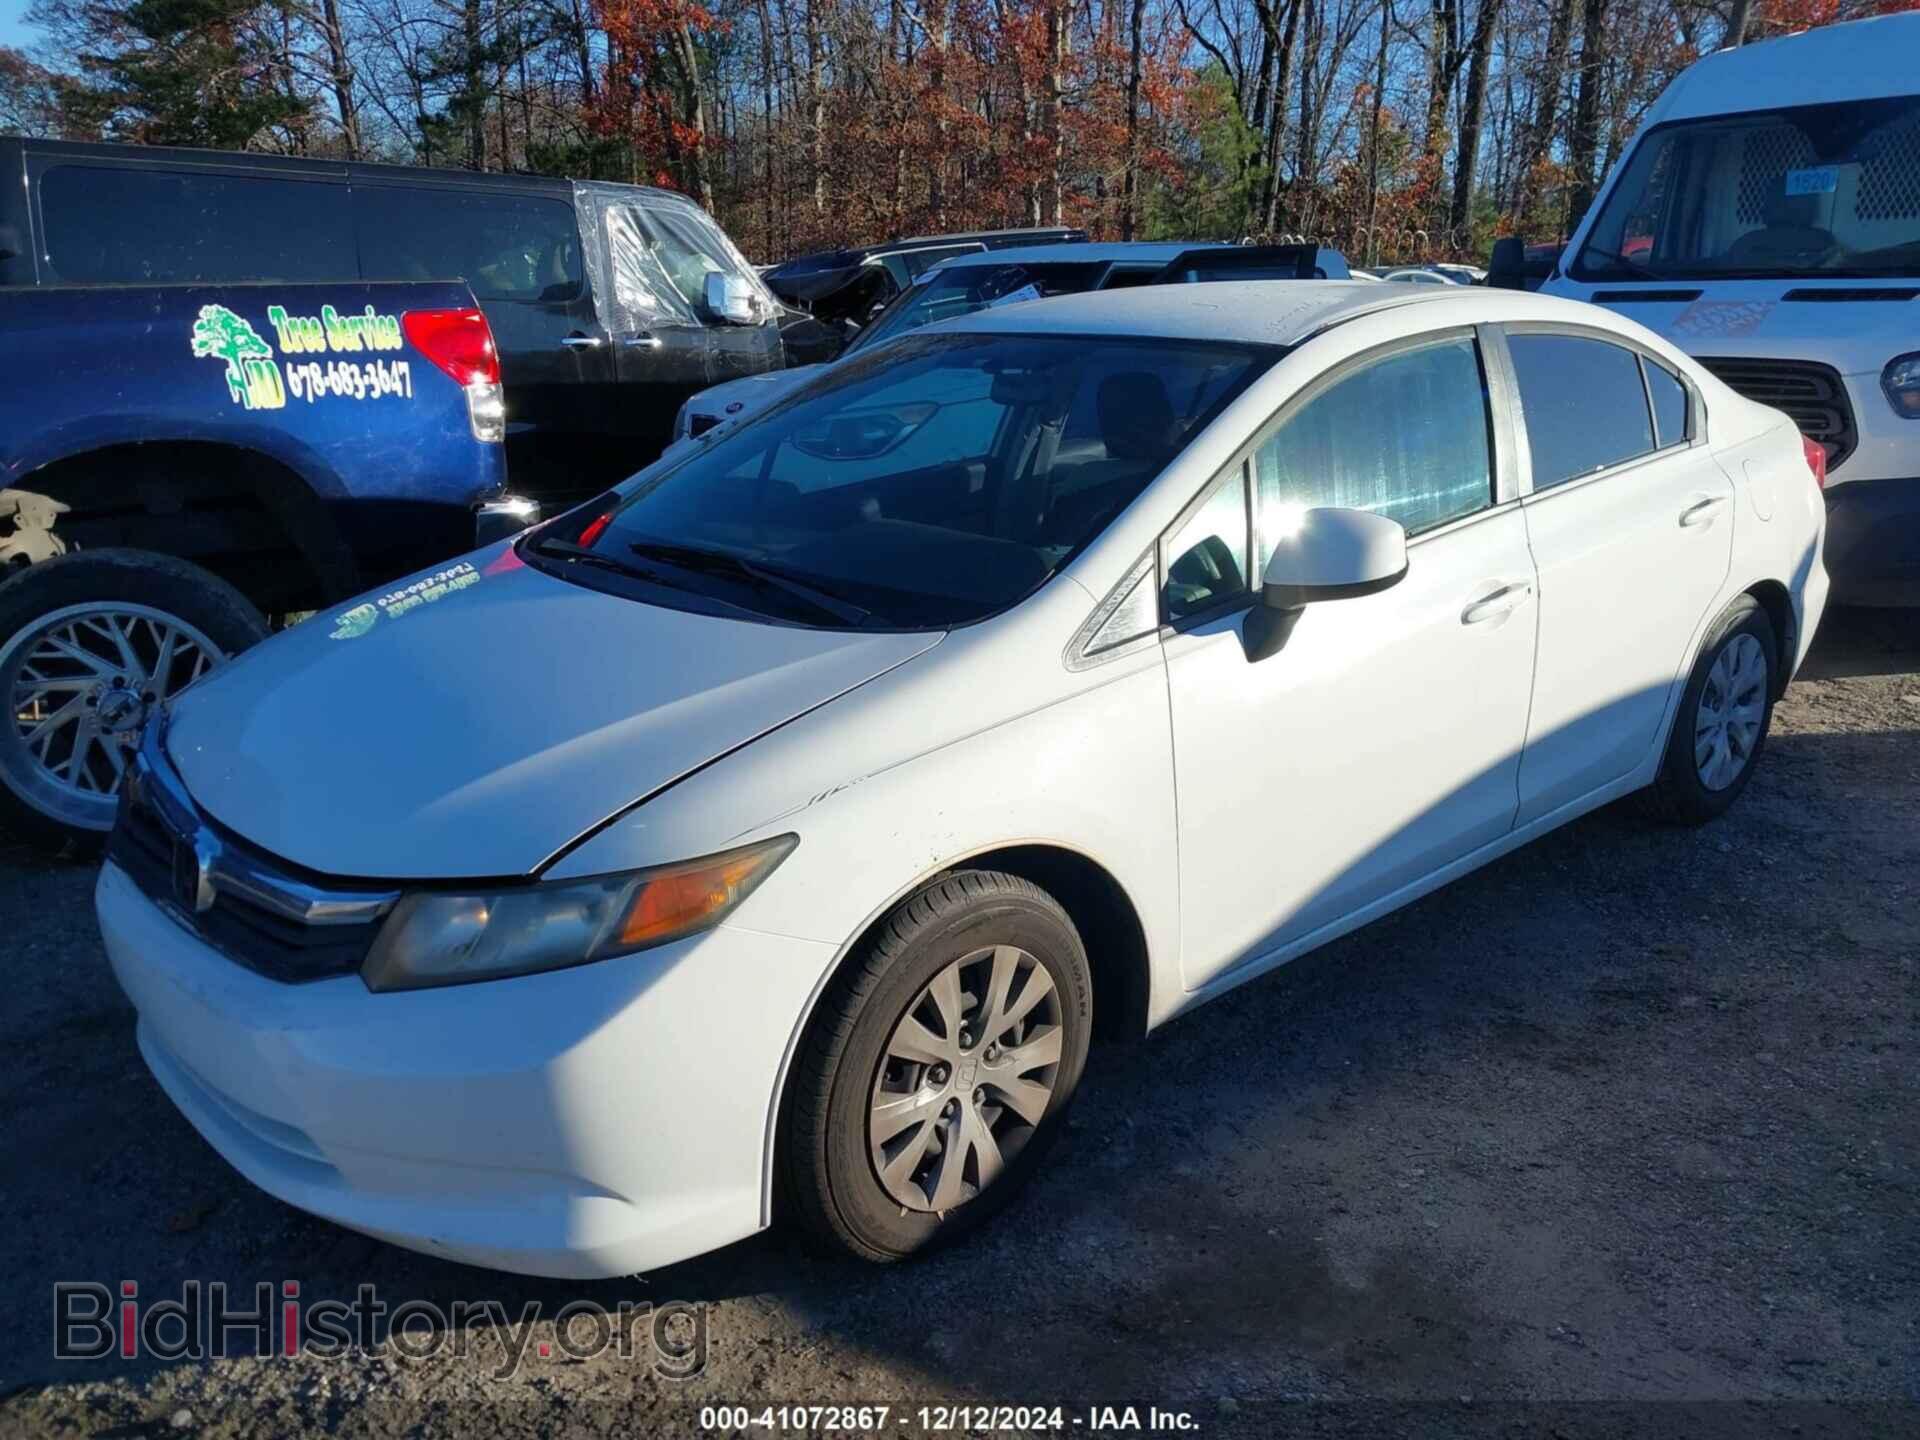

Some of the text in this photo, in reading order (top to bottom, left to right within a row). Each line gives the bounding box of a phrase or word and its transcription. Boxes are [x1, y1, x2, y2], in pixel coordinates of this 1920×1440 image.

[268, 304, 403, 353] Tree Service
[286, 361, 412, 403] 678-683-3647
